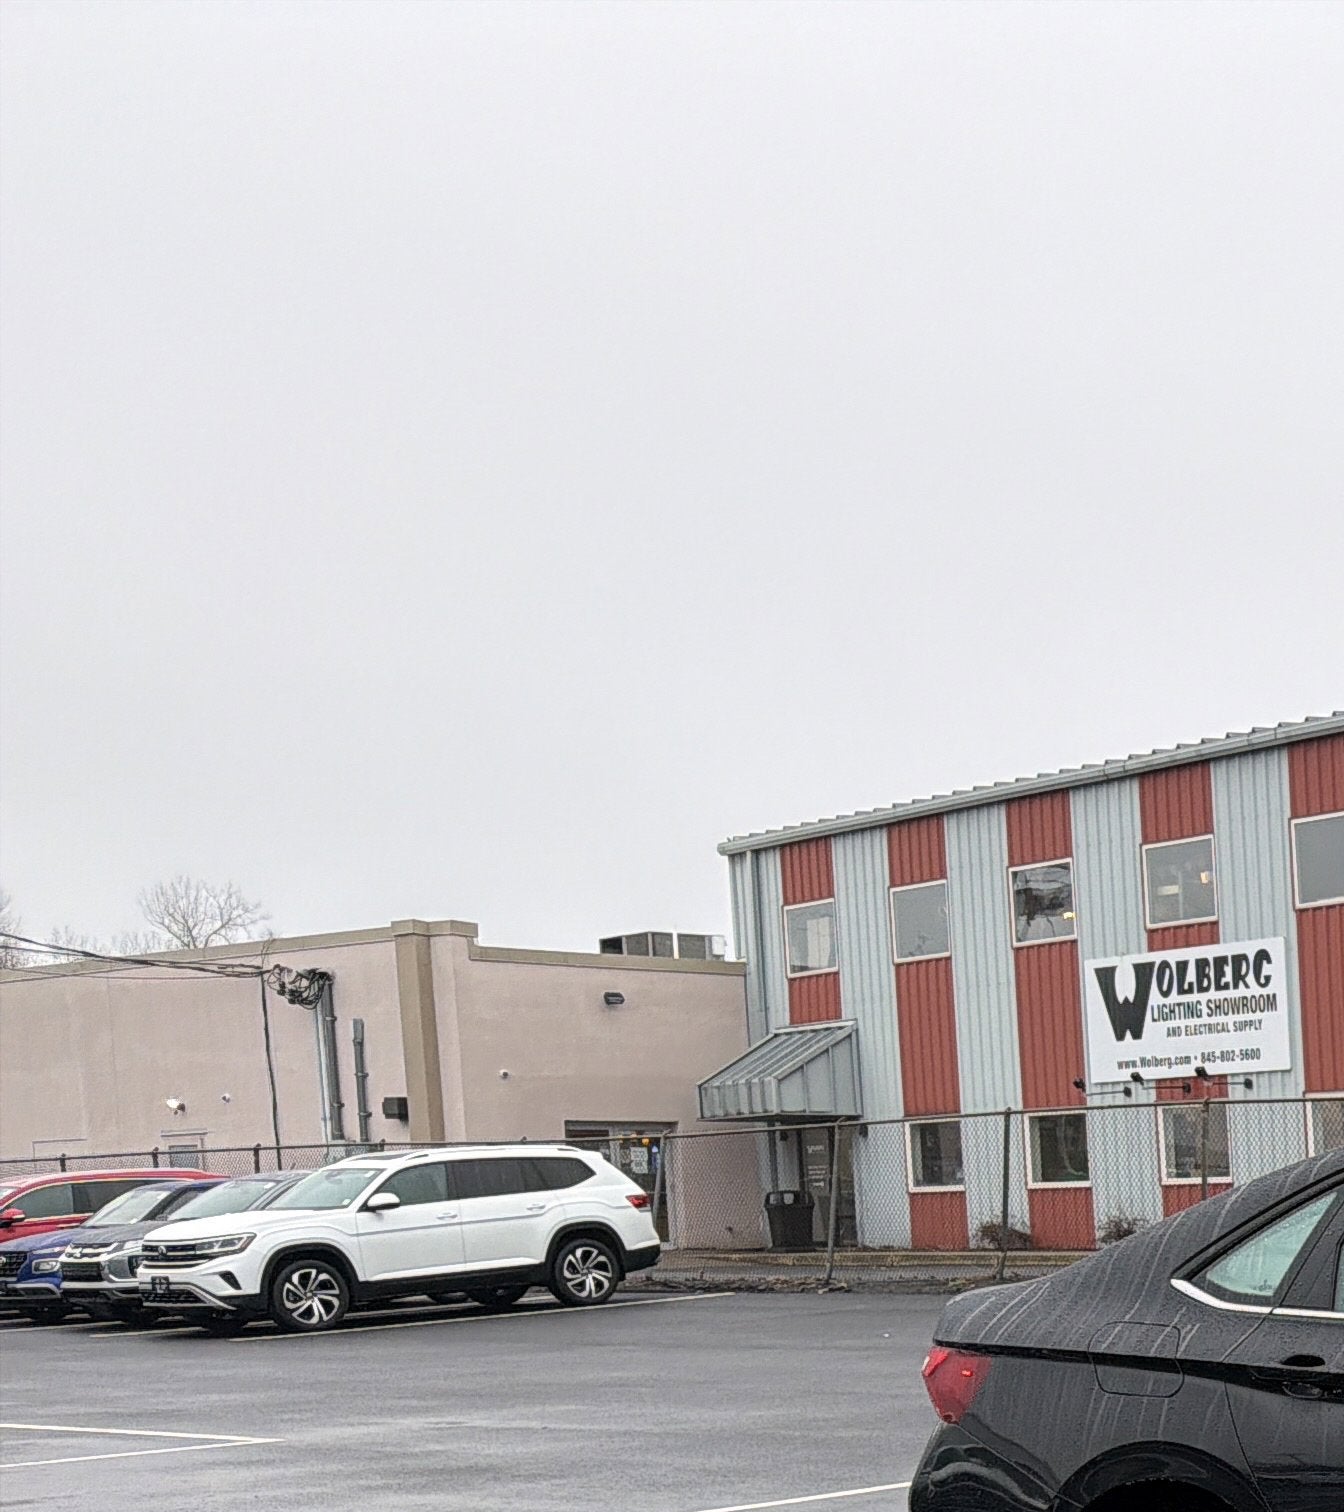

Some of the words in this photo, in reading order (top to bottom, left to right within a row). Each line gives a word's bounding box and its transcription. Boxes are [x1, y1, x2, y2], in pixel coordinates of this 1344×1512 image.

[1094, 948, 1273, 1042] WOLBERG
[1151, 1000, 1203, 1022] LIGHTING
[1206, 993, 1278, 1017] SHOWROOM
[1166, 1025, 1182, 1038] AND
[1185, 1022, 1231, 1036] ELECTRICAL
[1233, 1019, 1263, 1032] SUPPLY
[1117, 1055, 1192, 1070] www.Wolberg.com
[1200, 1048, 1261, 1064] 845-802-5600
